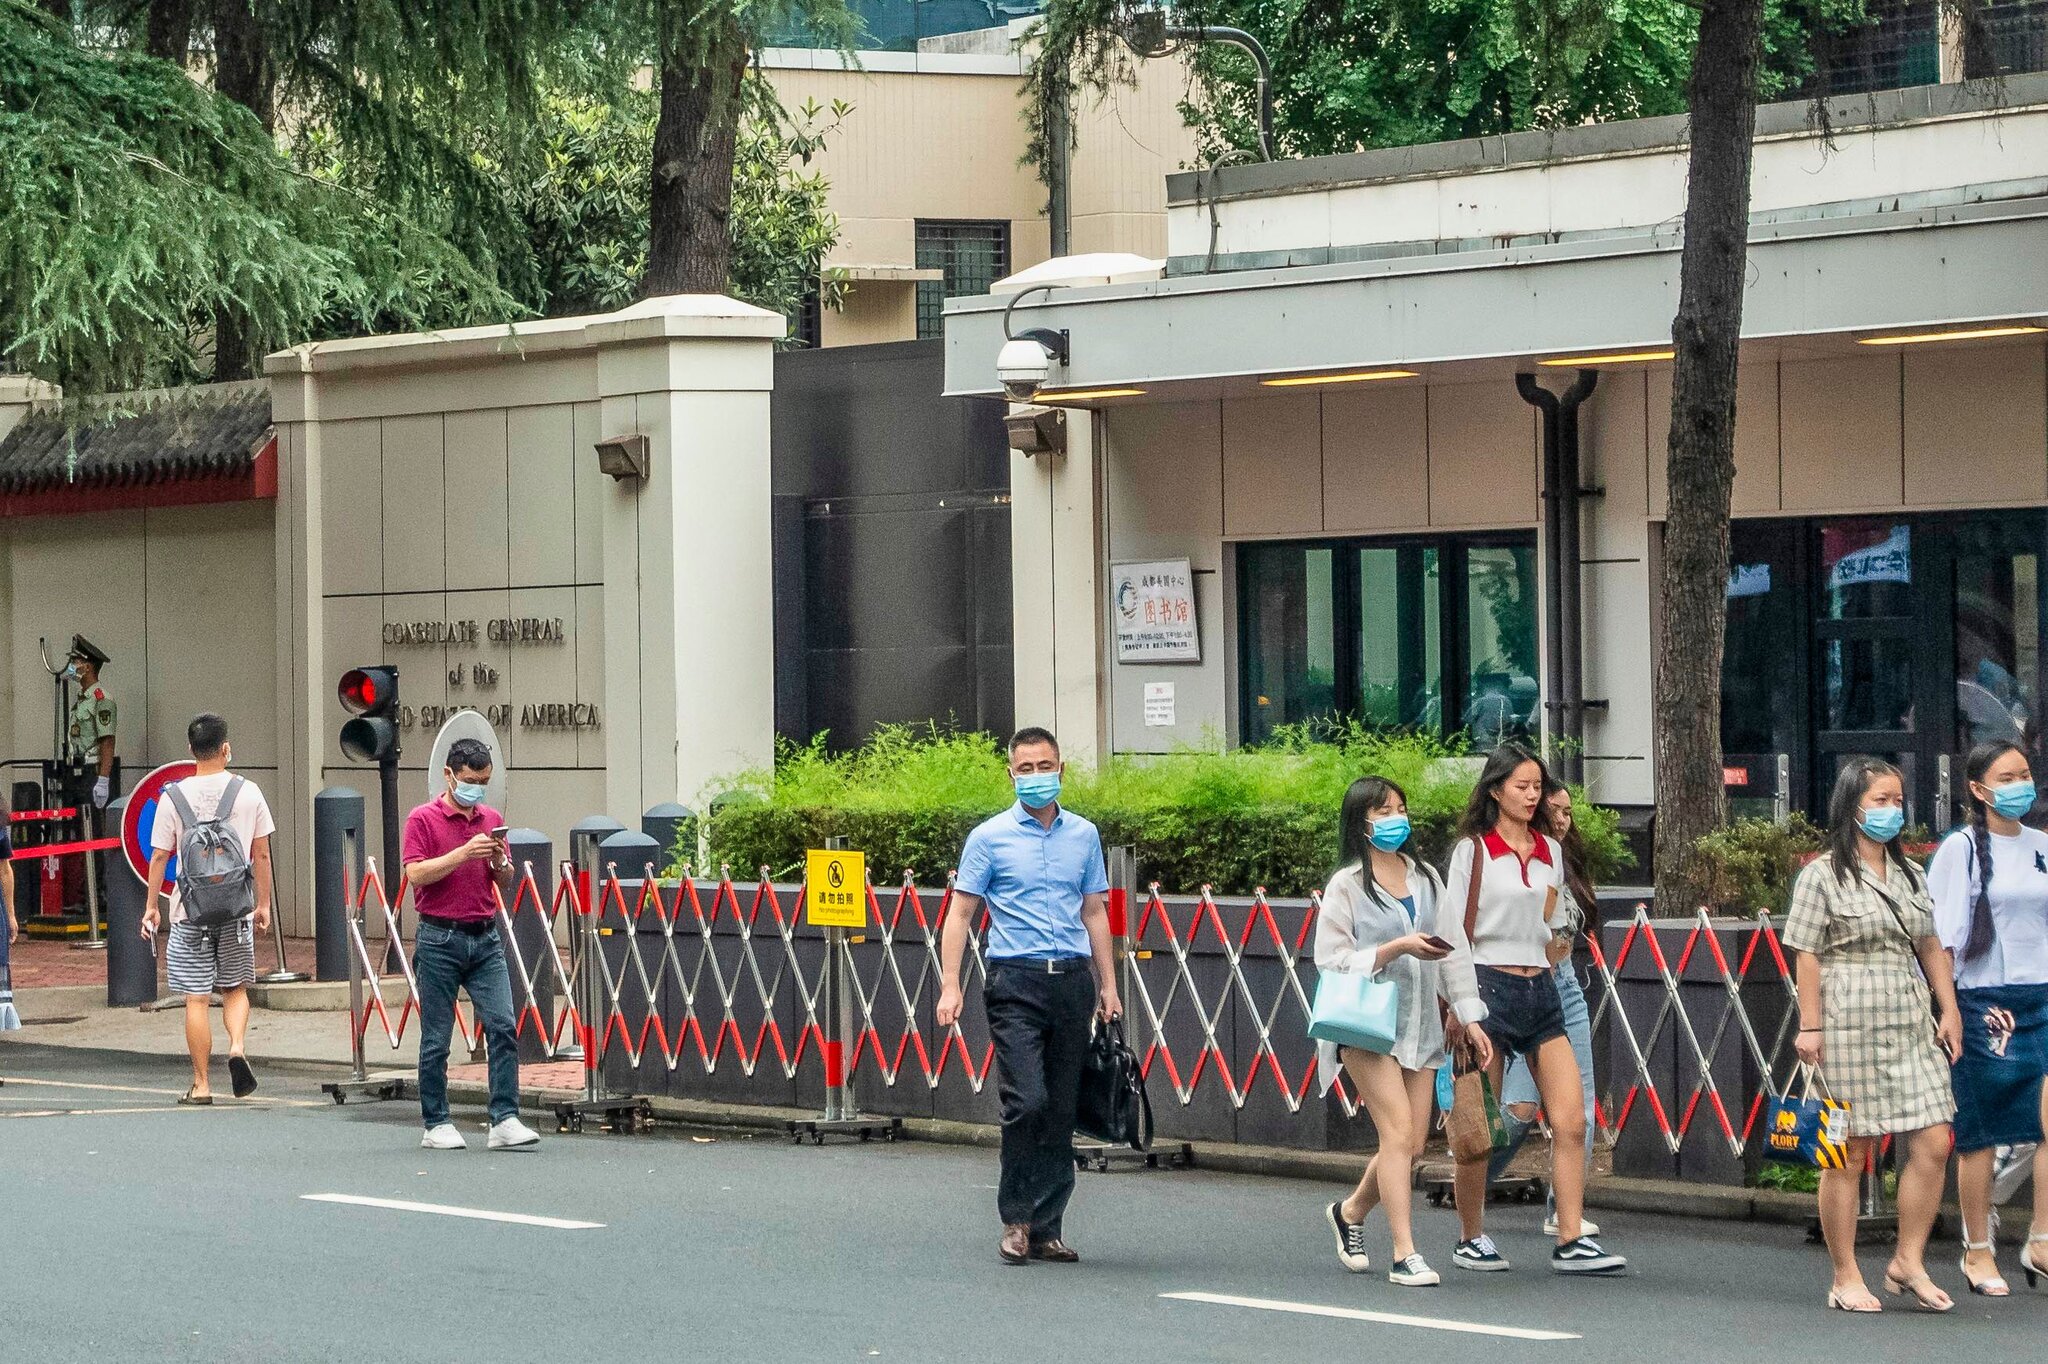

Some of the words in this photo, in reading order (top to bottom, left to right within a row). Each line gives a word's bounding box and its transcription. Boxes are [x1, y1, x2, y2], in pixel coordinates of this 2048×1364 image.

[1143, 596, 1189, 625] 图书馆
[382, 619, 479, 645] CONSULATE
[486, 617, 565, 643] GENERAL
[448, 663, 466, 685] of
[472, 662, 501, 685] the
[420, 704, 478, 728] STA
[487, 704, 512, 727] OF
[519, 702, 602, 727] AMERICA
[818, 891, 854, 905] 请勿拍照
